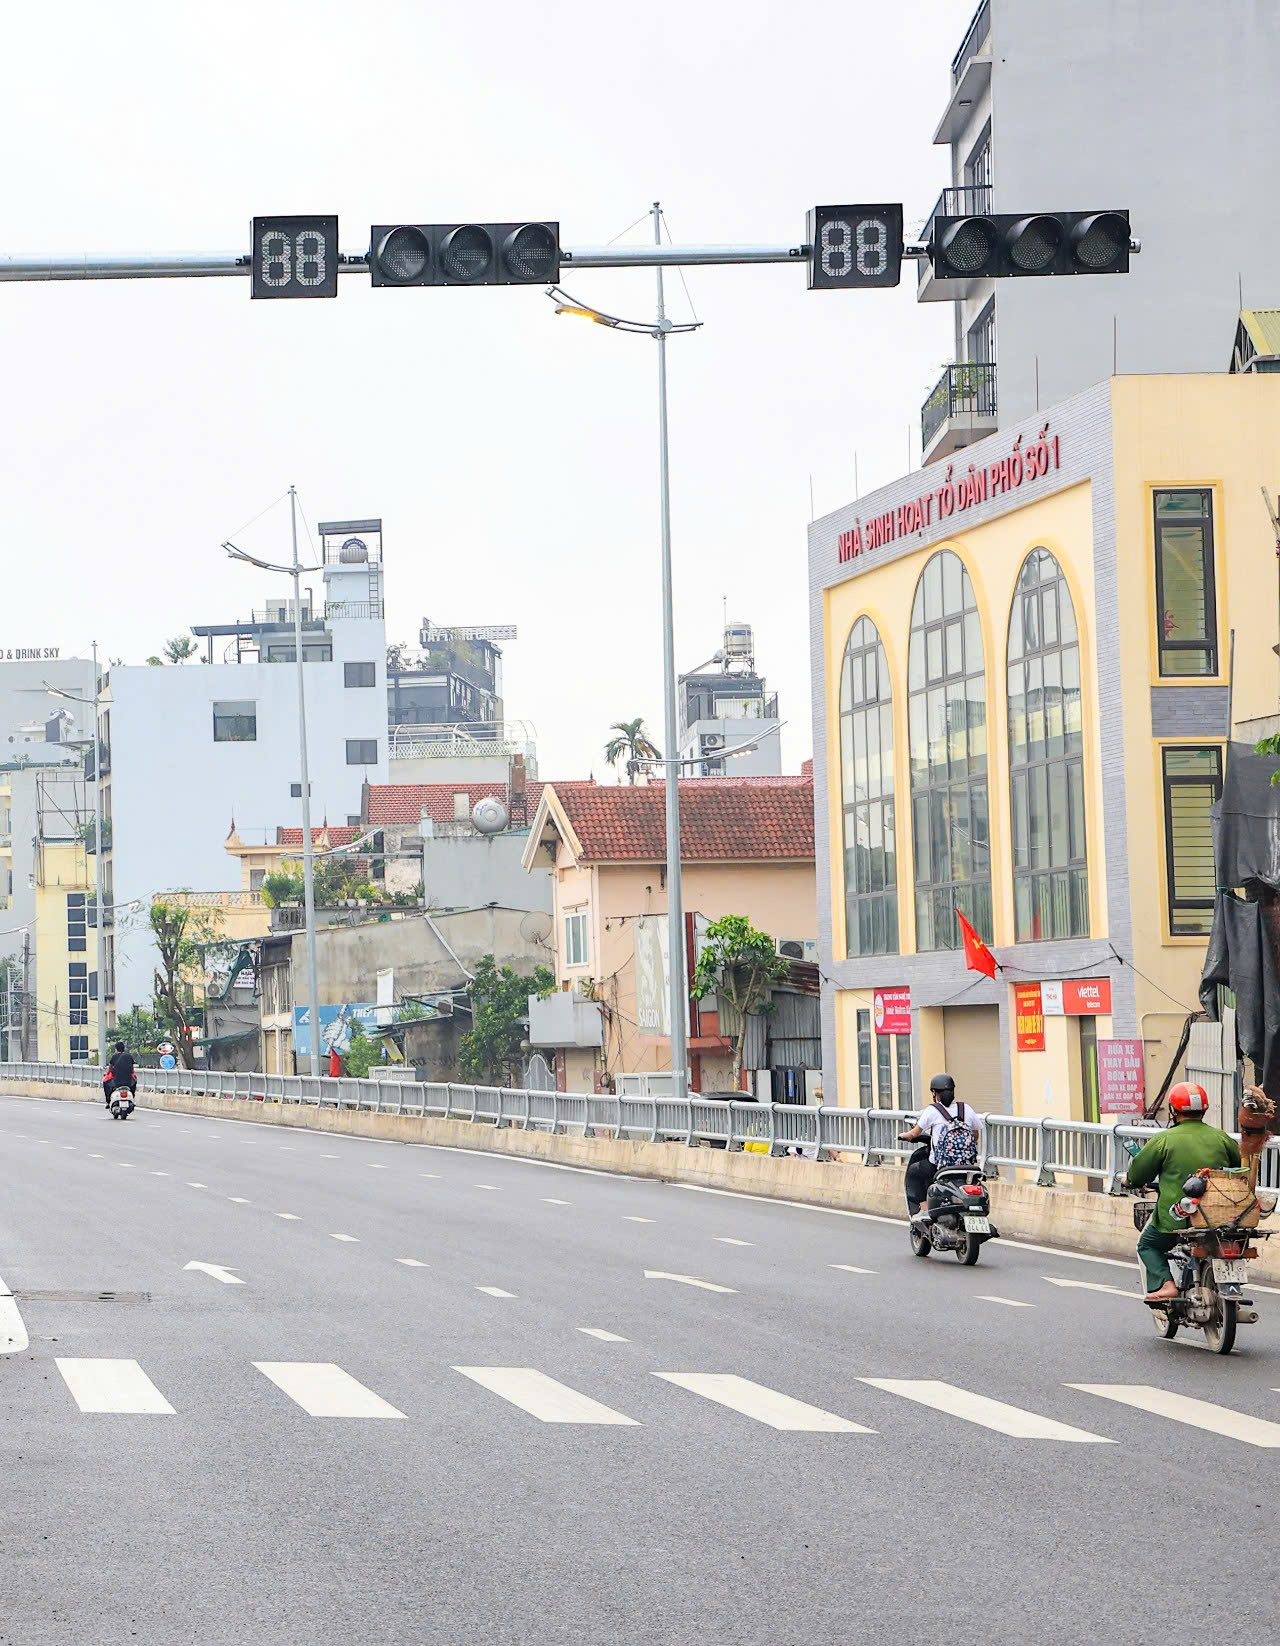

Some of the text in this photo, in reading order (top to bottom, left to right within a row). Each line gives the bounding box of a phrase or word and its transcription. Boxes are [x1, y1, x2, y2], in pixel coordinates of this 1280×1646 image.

[838, 422, 1061, 564] NHÀ SINH HOẠT TỔ DÂN PHỐ SỐ 1
[7, 649, 13, 659] &
[15, 648, 41, 660] DRINK
[44, 647, 60, 659] SKY
[1077, 985, 1100, 998] viettel
[639, 1008, 660, 1027] SAIGON
